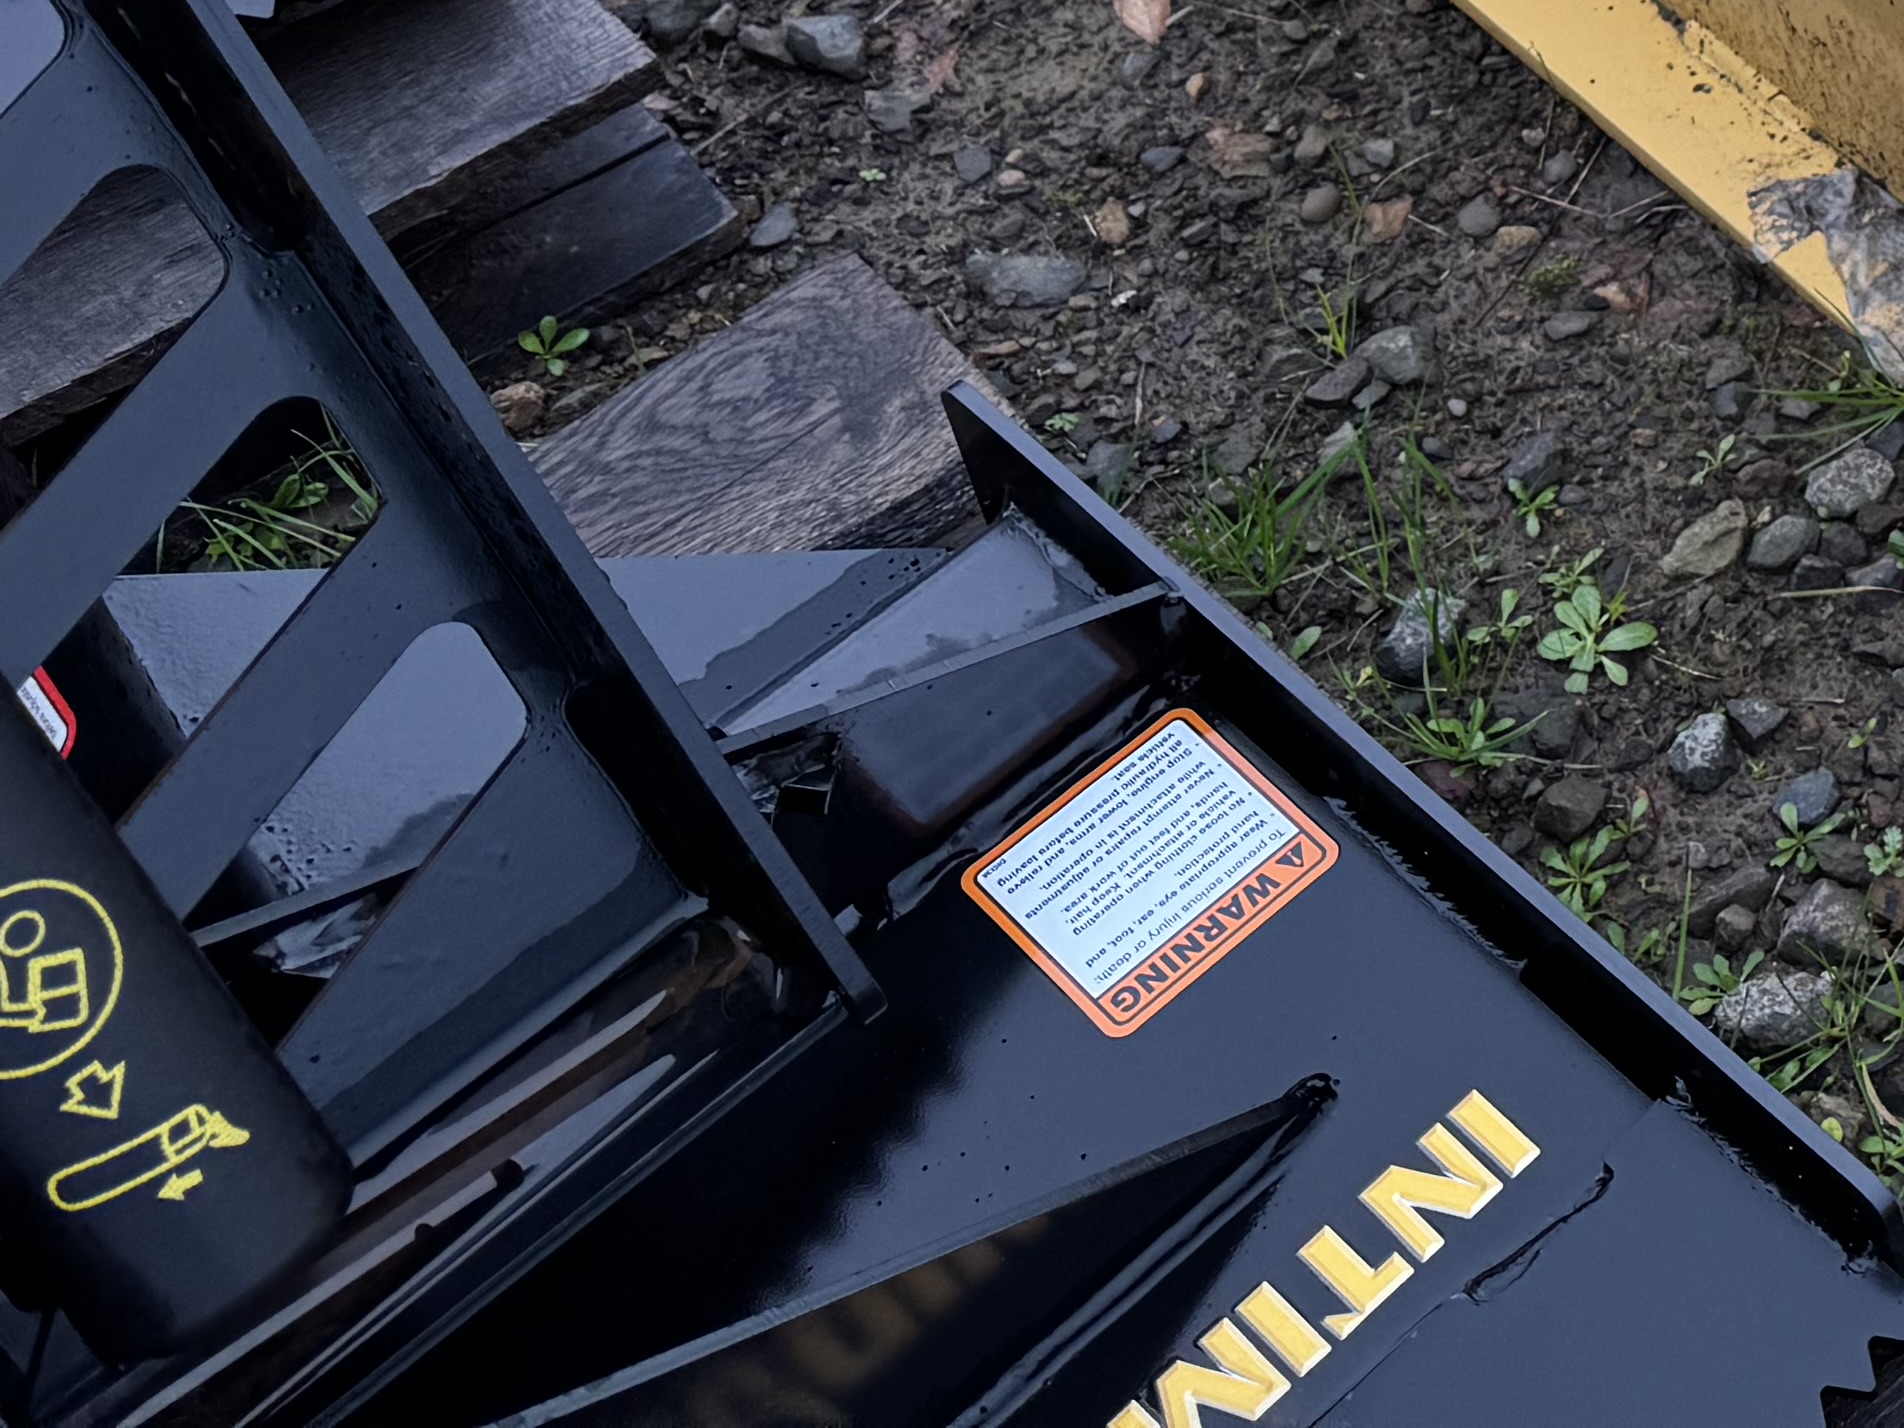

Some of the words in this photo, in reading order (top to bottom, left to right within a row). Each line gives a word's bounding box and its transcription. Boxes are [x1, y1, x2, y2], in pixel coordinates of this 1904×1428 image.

[1266, 826, 1285, 843] To
[1221, 837, 1269, 879] prevent
[1179, 875, 1225, 914] serious
[1106, 869, 1282, 1017] WARNING
[1144, 909, 1182, 943] injury
